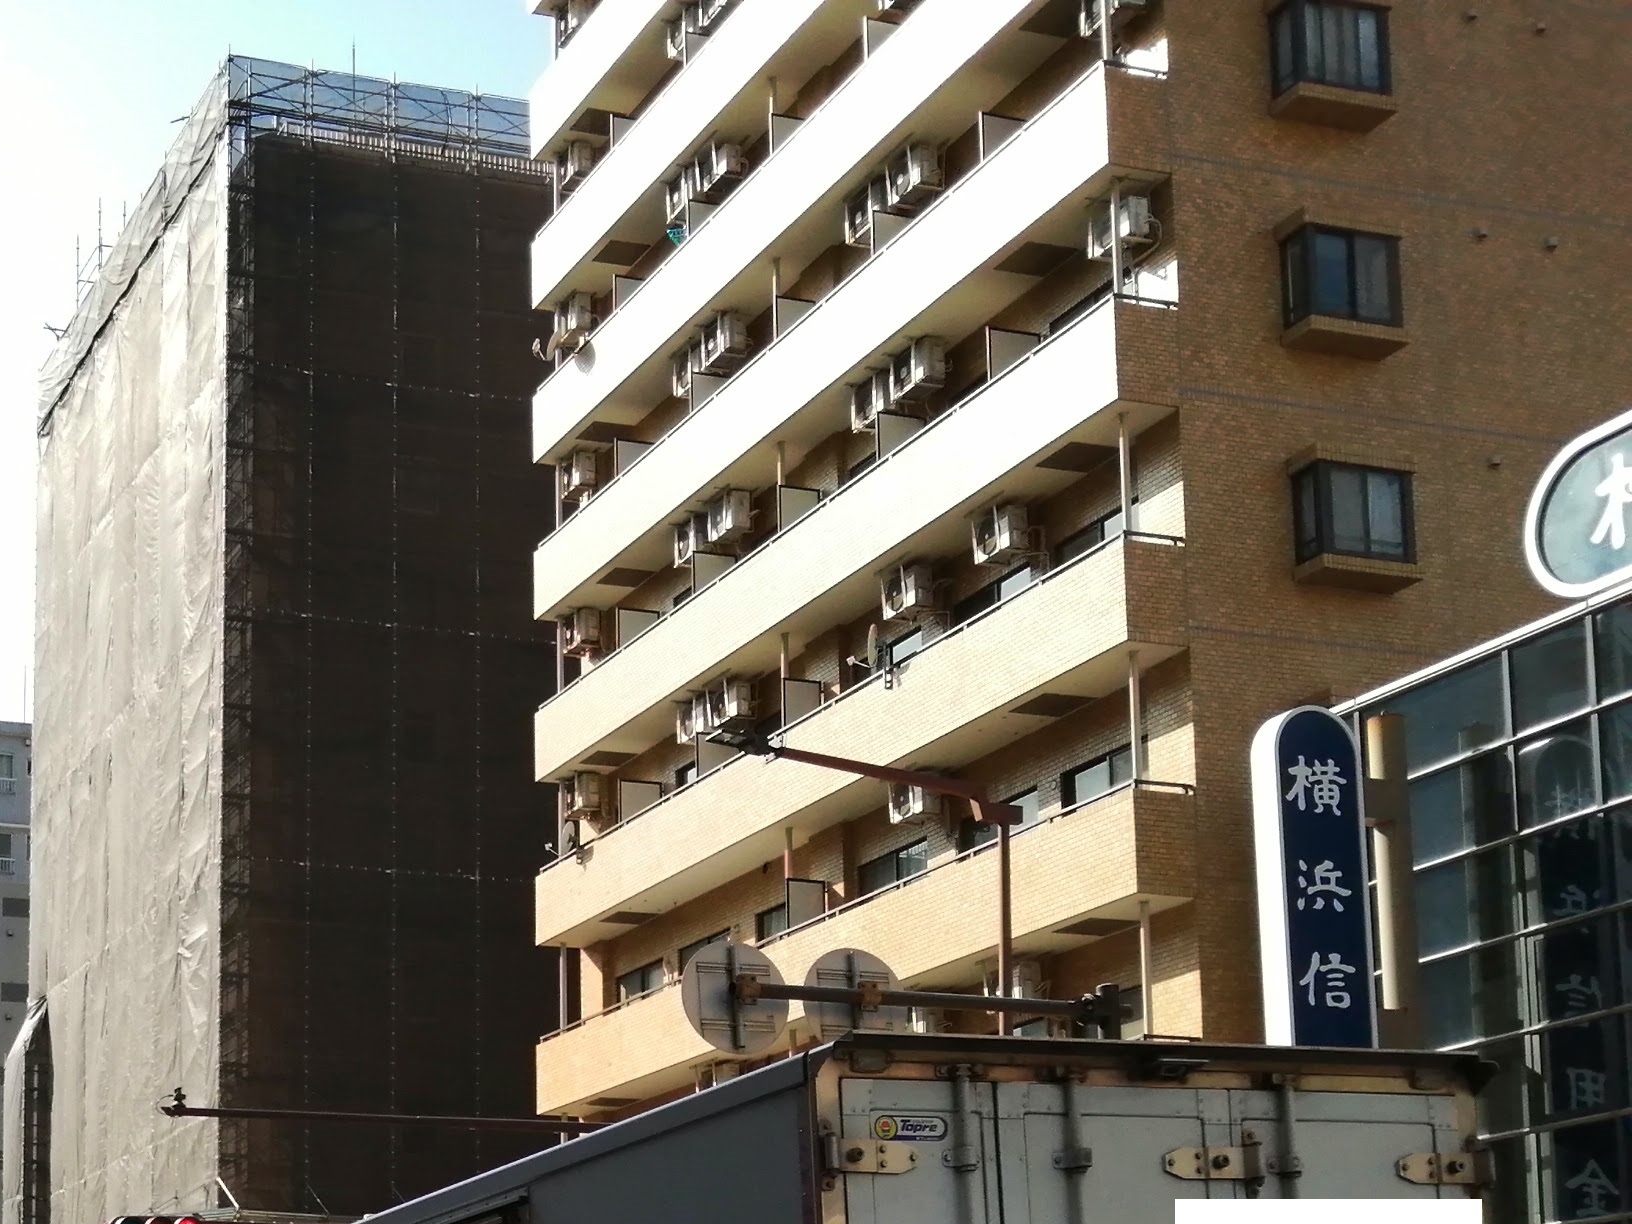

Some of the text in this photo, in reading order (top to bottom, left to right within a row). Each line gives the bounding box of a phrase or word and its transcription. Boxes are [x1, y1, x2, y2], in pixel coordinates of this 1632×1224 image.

[1285, 755, 1357, 1009] 横浜信
[900, 1119, 938, 1134] Topre
